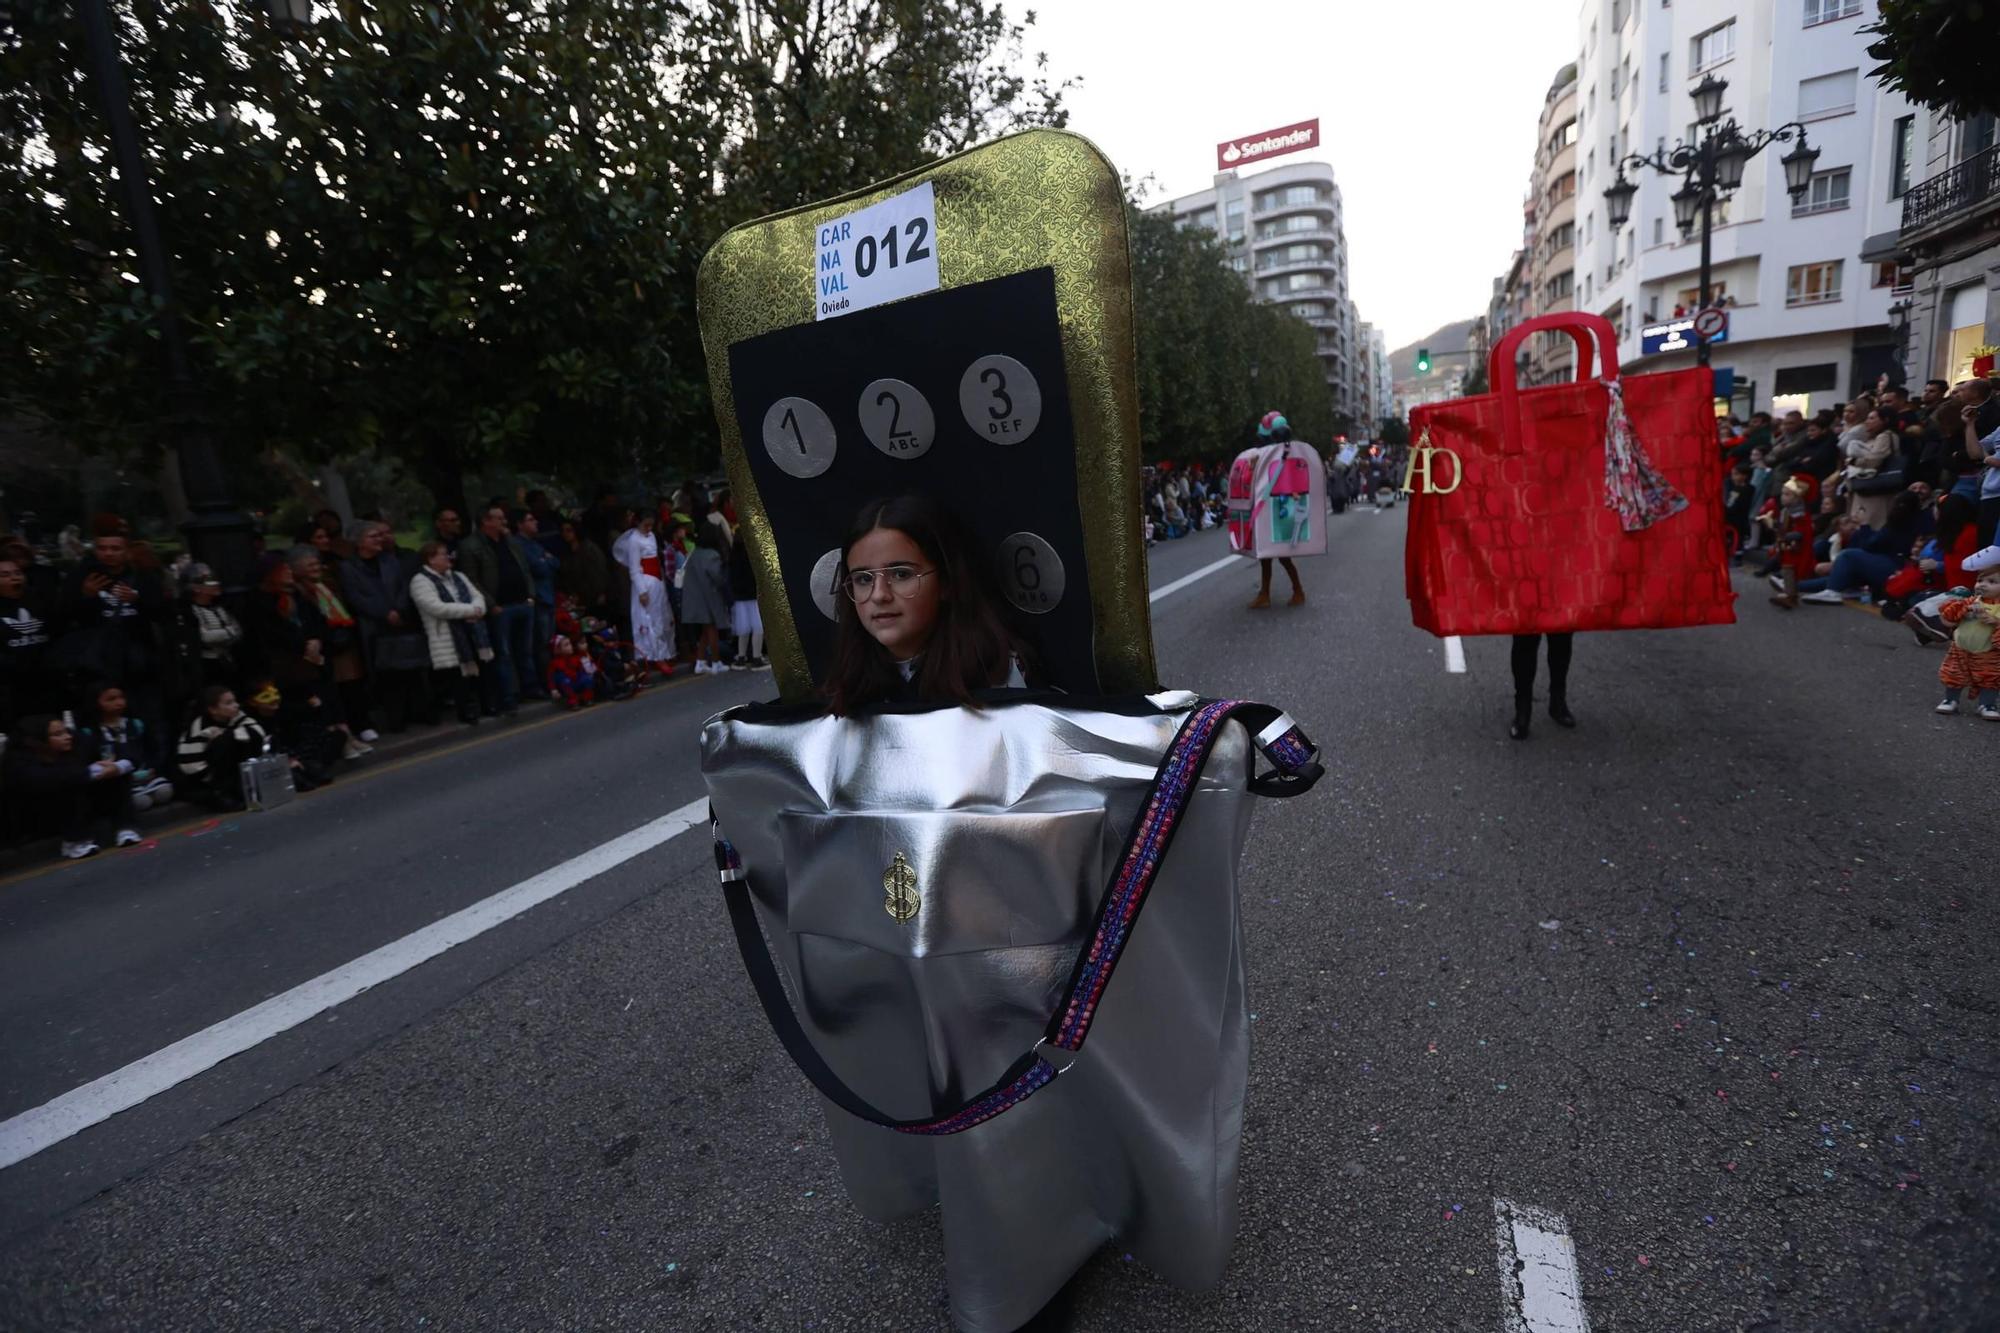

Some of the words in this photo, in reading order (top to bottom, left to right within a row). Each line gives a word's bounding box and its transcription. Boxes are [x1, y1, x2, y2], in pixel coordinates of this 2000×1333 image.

[1241, 129, 1313, 158] Santander
[821, 221, 851, 247] CAR
[855, 216, 930, 278] 012
[821, 249, 842, 272] NA
[821, 272, 849, 296] VAL
[822, 297, 850, 314] Oviedo
[980, 368, 1013, 420] 3
[876, 391, 912, 439] 2
[988, 419, 1022, 434] DEF
[780, 408, 807, 455] 1
[888, 437, 920, 451] ABC
[1014, 545, 1041, 591] 6
